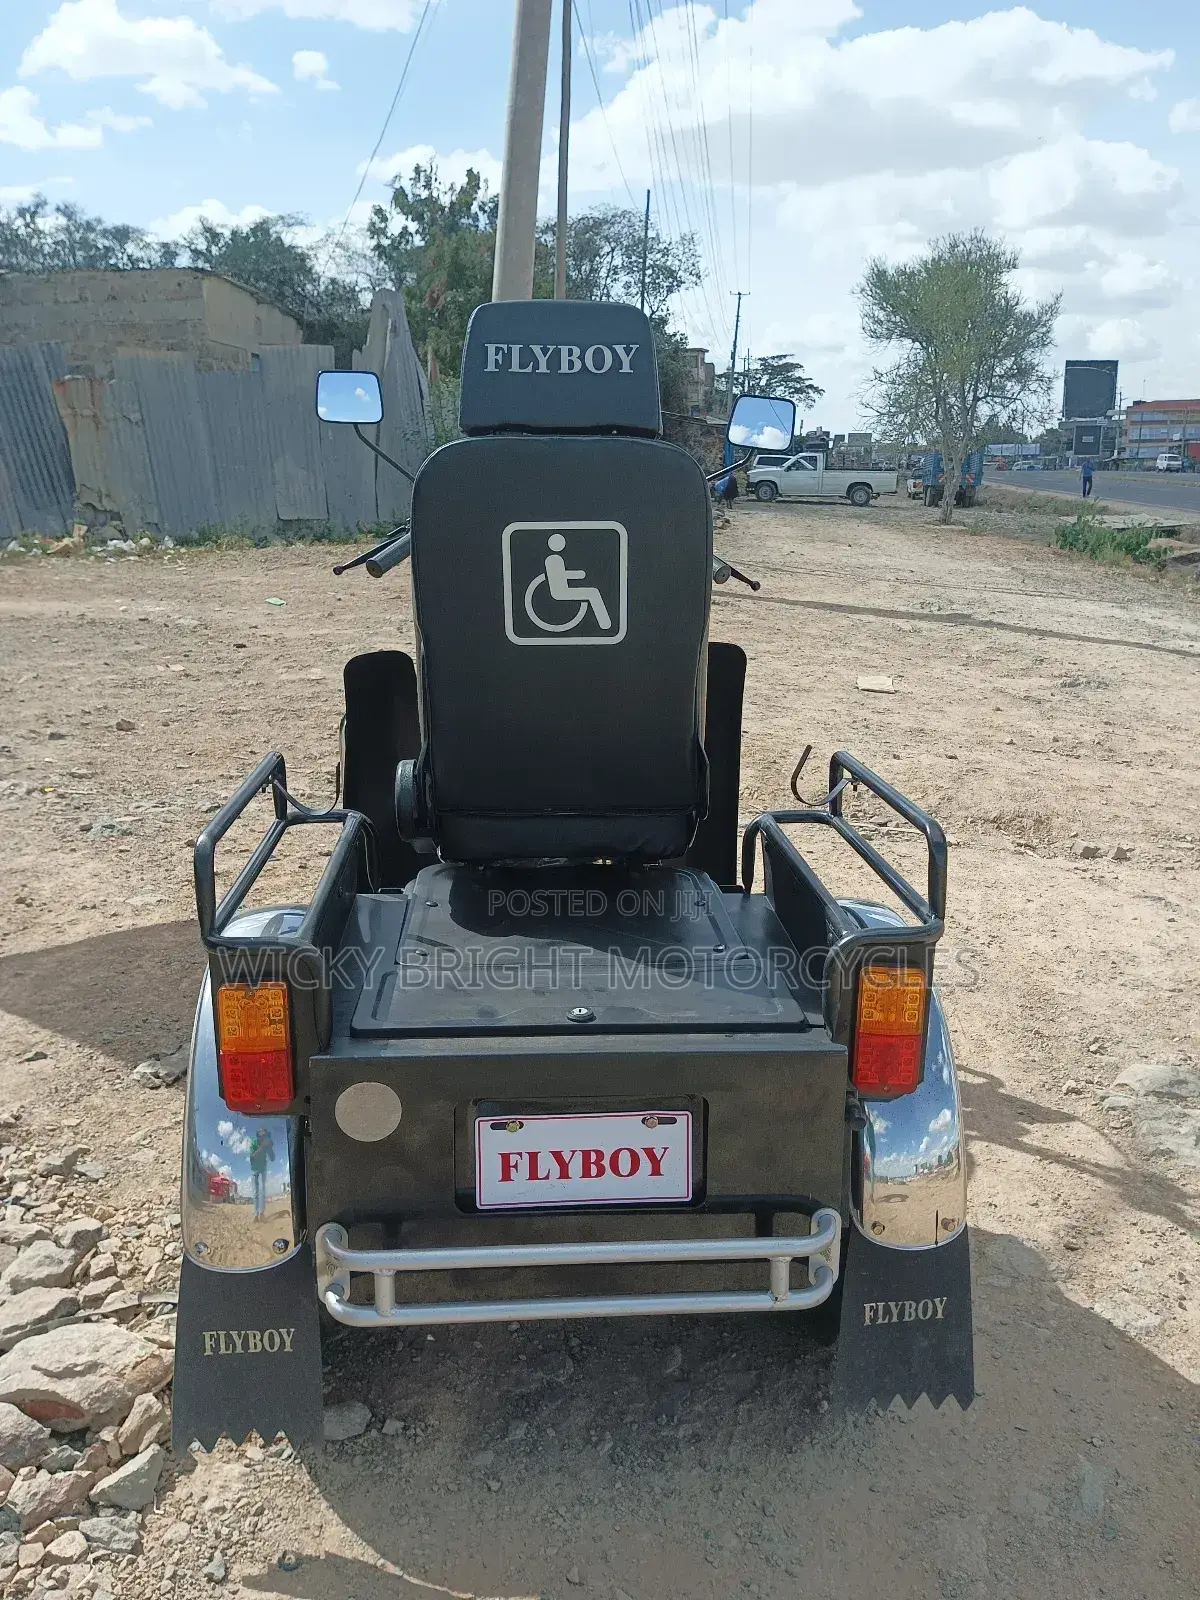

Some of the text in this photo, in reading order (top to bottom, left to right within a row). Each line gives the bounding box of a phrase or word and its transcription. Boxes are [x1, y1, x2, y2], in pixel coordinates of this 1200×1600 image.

[484, 343, 640, 374] FLYBOY
[498, 1146, 669, 1183] FLYBOY
[863, 1297, 947, 1326] FLYBOY
[202, 1328, 295, 1356] FLYBOY
